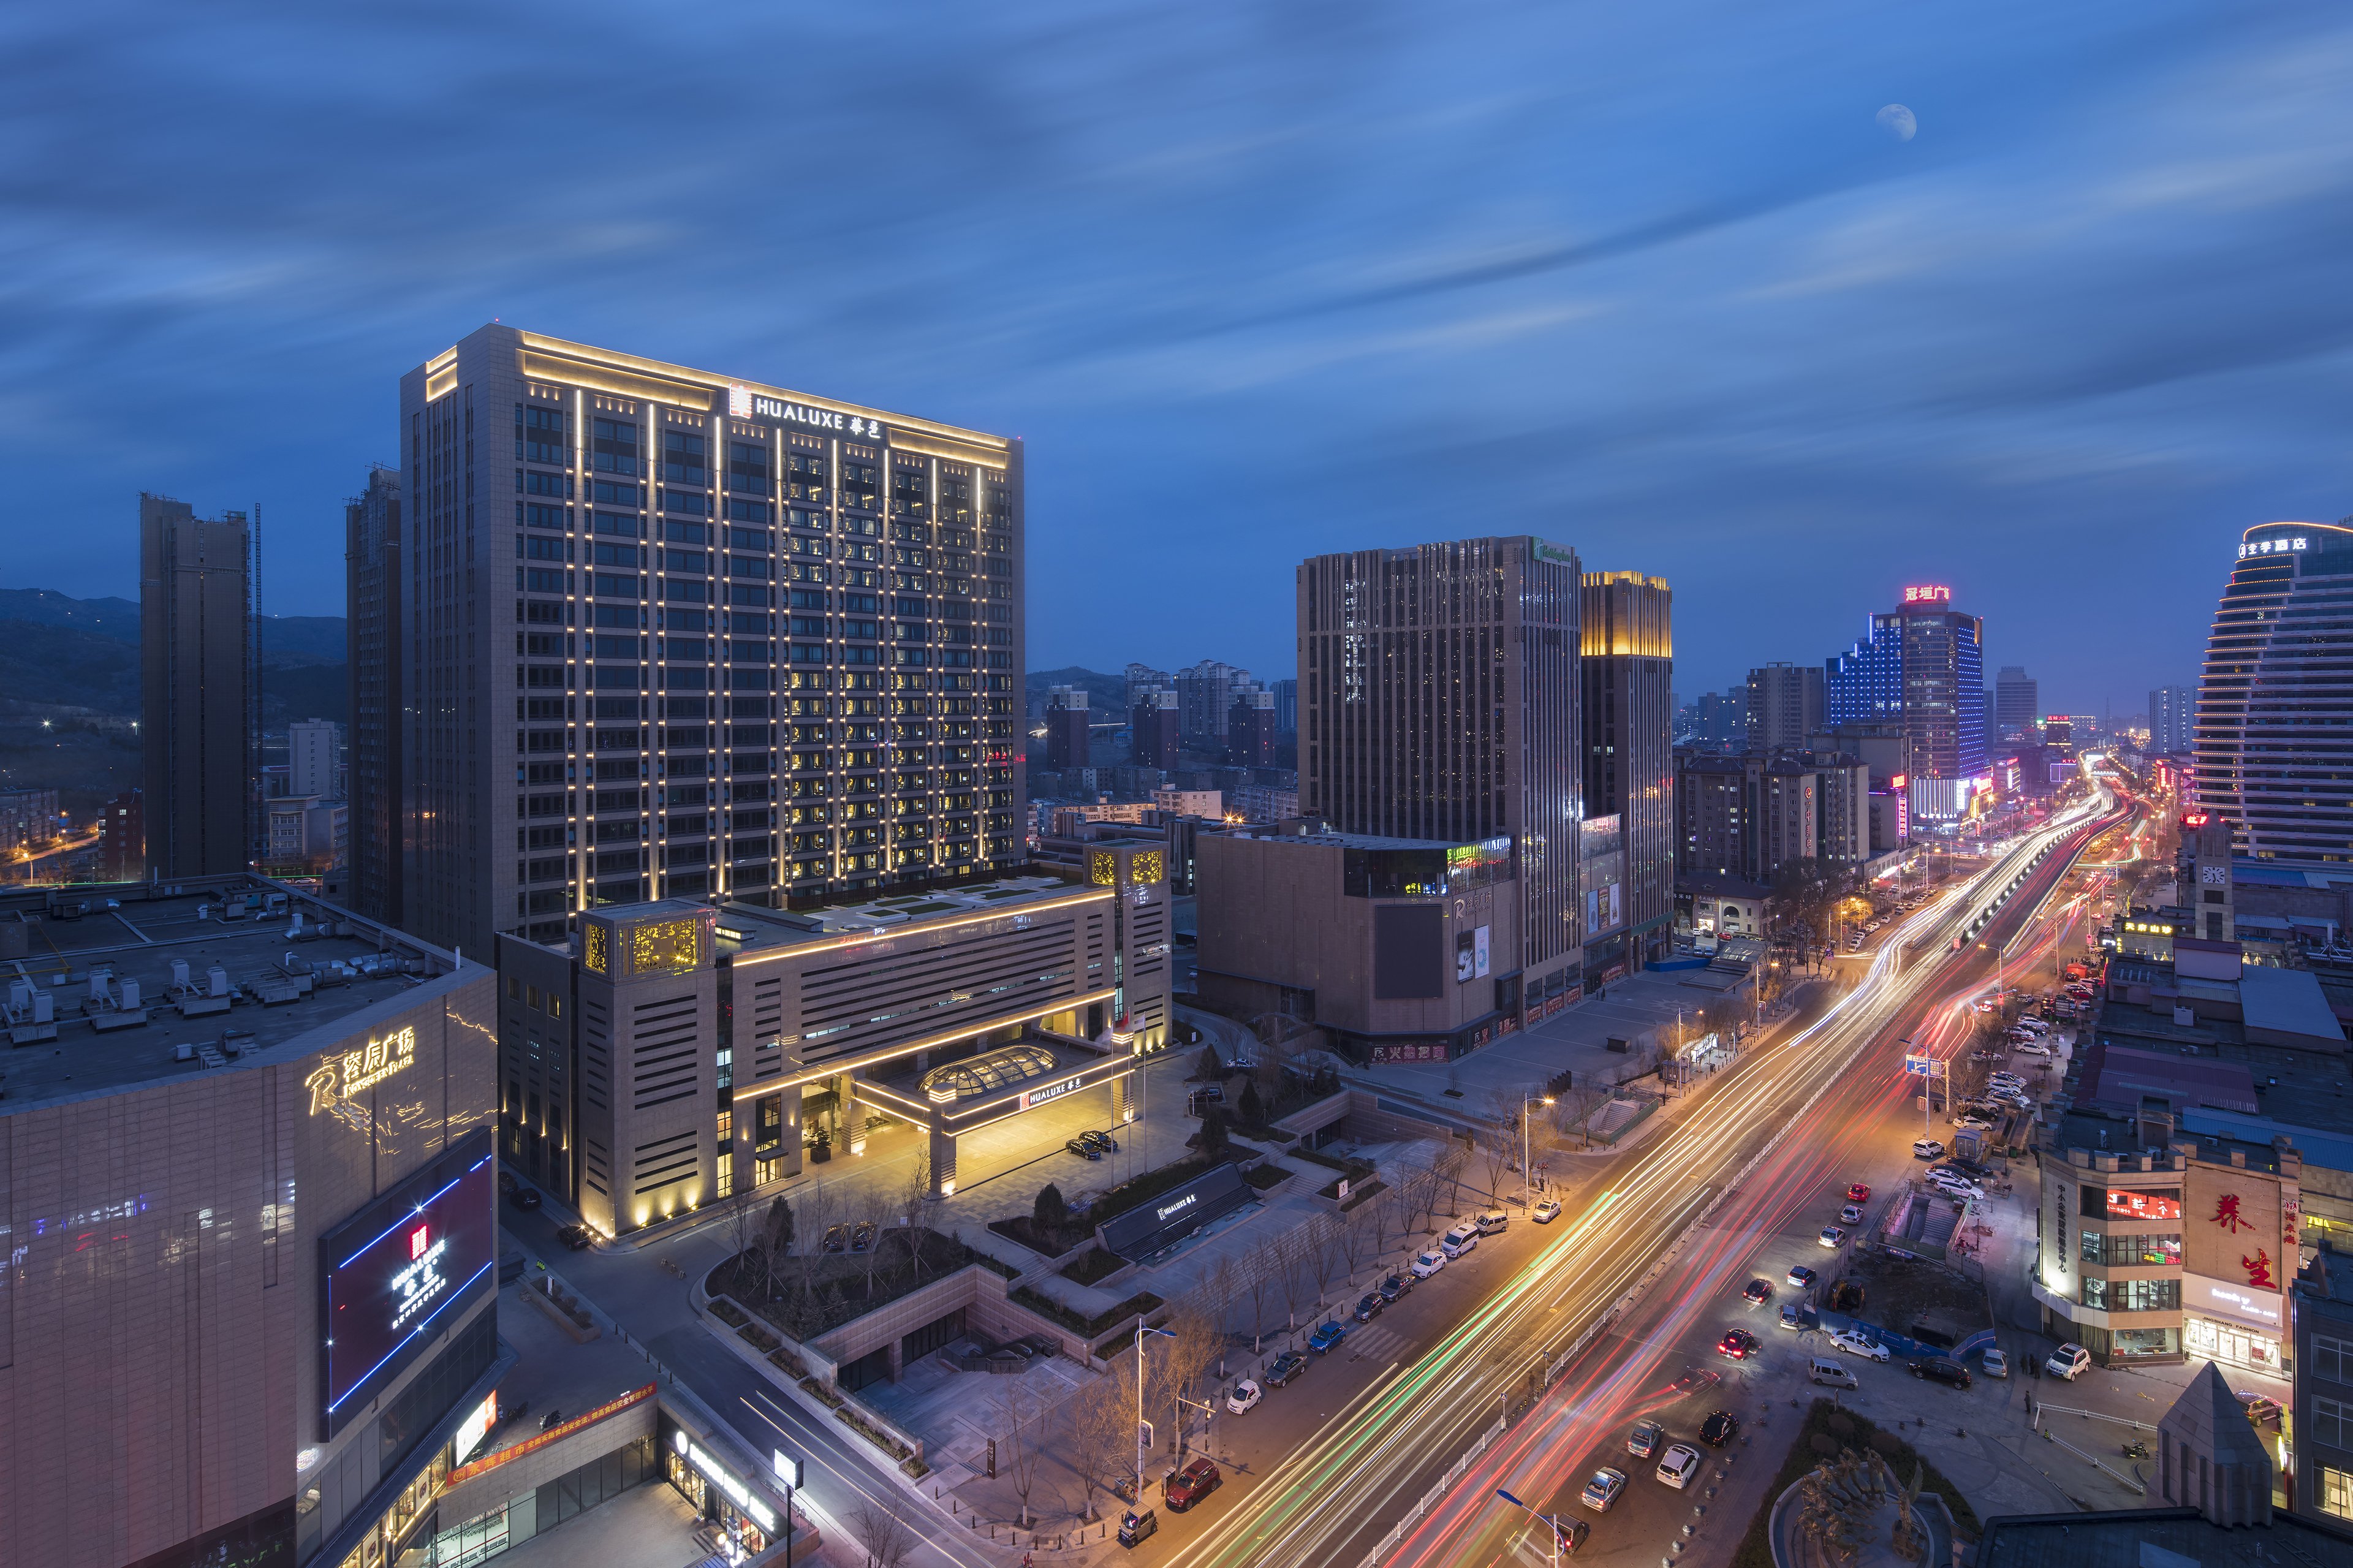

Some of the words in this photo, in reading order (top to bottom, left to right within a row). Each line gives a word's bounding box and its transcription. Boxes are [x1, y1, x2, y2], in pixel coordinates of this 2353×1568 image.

[757, 398, 843, 430] HUALUXE
[1543, 545, 1562, 562] Holiday
[2248, 538, 2306, 555] 全季酒店
[2125, 922, 2172, 934] 天府山珍
[343, 1026, 415, 1083] 容辰广场
[1030, 1084, 1066, 1104] HUALUXE
[1164, 1199, 1187, 1215] HUALUXE
[392, 1239, 445, 1290] HUALUXE
[2202, 1316, 2232, 1327] JINGSHANG
[2235, 1325, 2259, 1334] FASHION
[469, 1444, 526, 1477] 永辉超市
